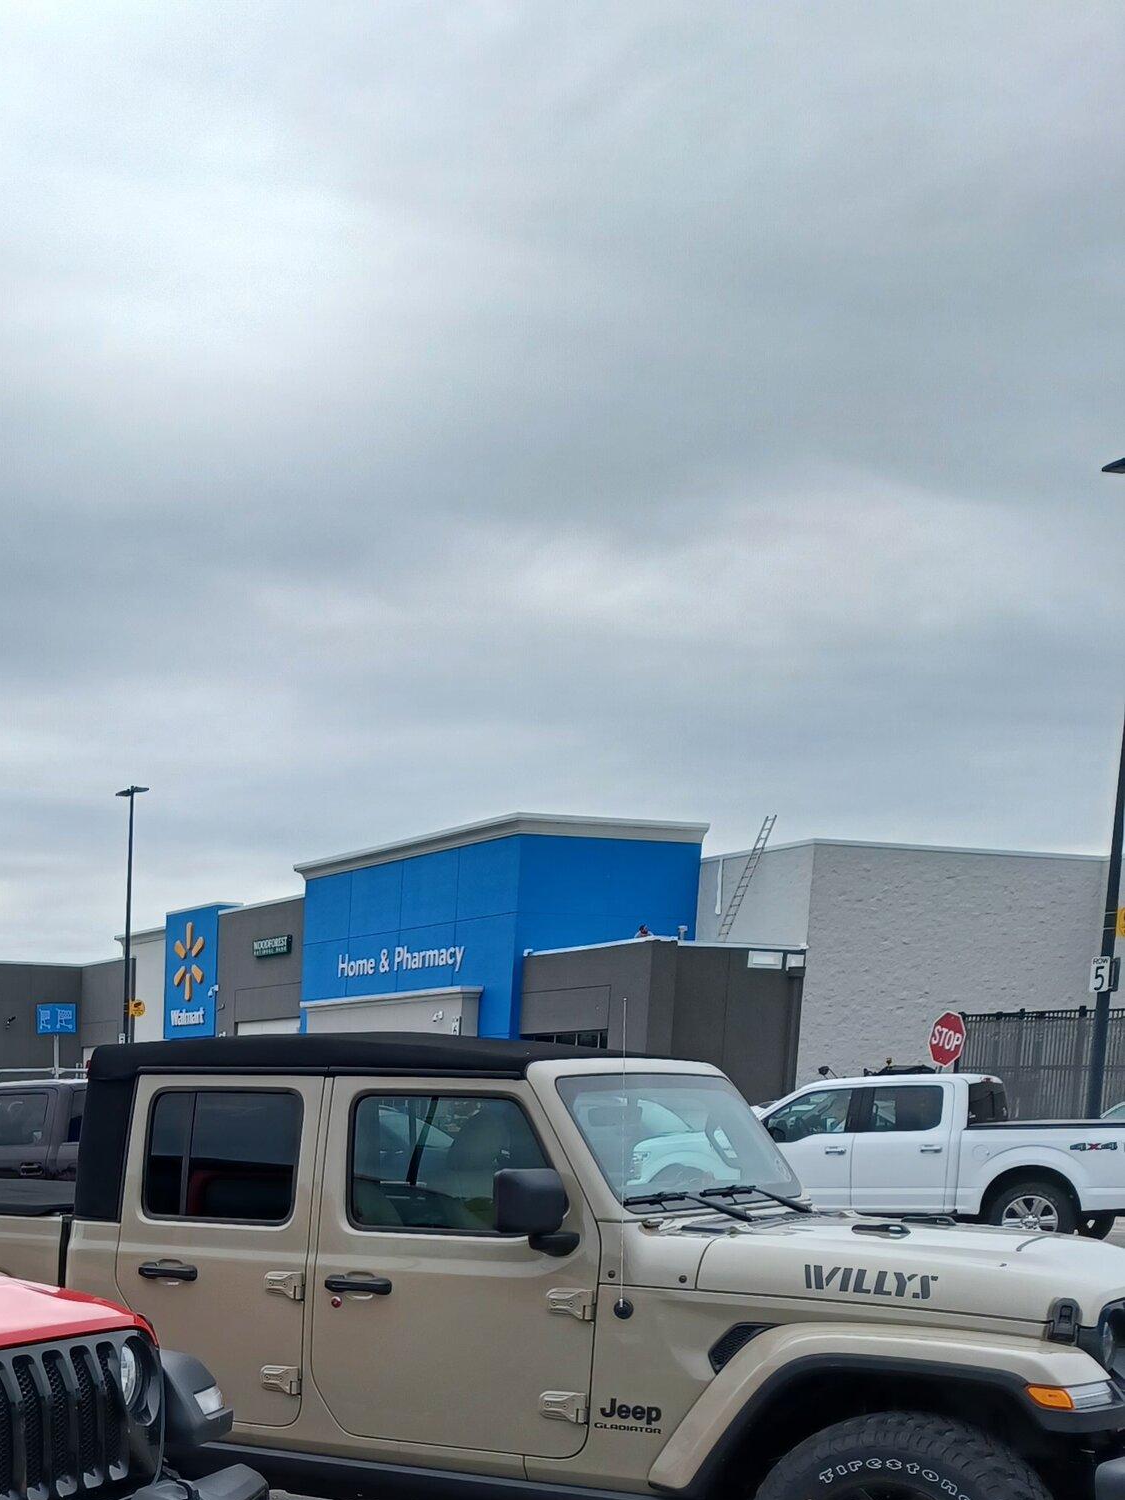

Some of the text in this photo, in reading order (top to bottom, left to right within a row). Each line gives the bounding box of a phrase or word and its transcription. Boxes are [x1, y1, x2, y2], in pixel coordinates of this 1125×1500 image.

[338, 945, 465, 978] Home & Pharmacy
[1093, 965, 1105, 991] 5
[170, 1007, 205, 1026] Walmart
[931, 1024, 963, 1052] STOP
[804, 1264, 939, 1300] WILLYS
[600, 1398, 662, 1425] Jeep
[594, 1422, 662, 1435] GLADIATOR
